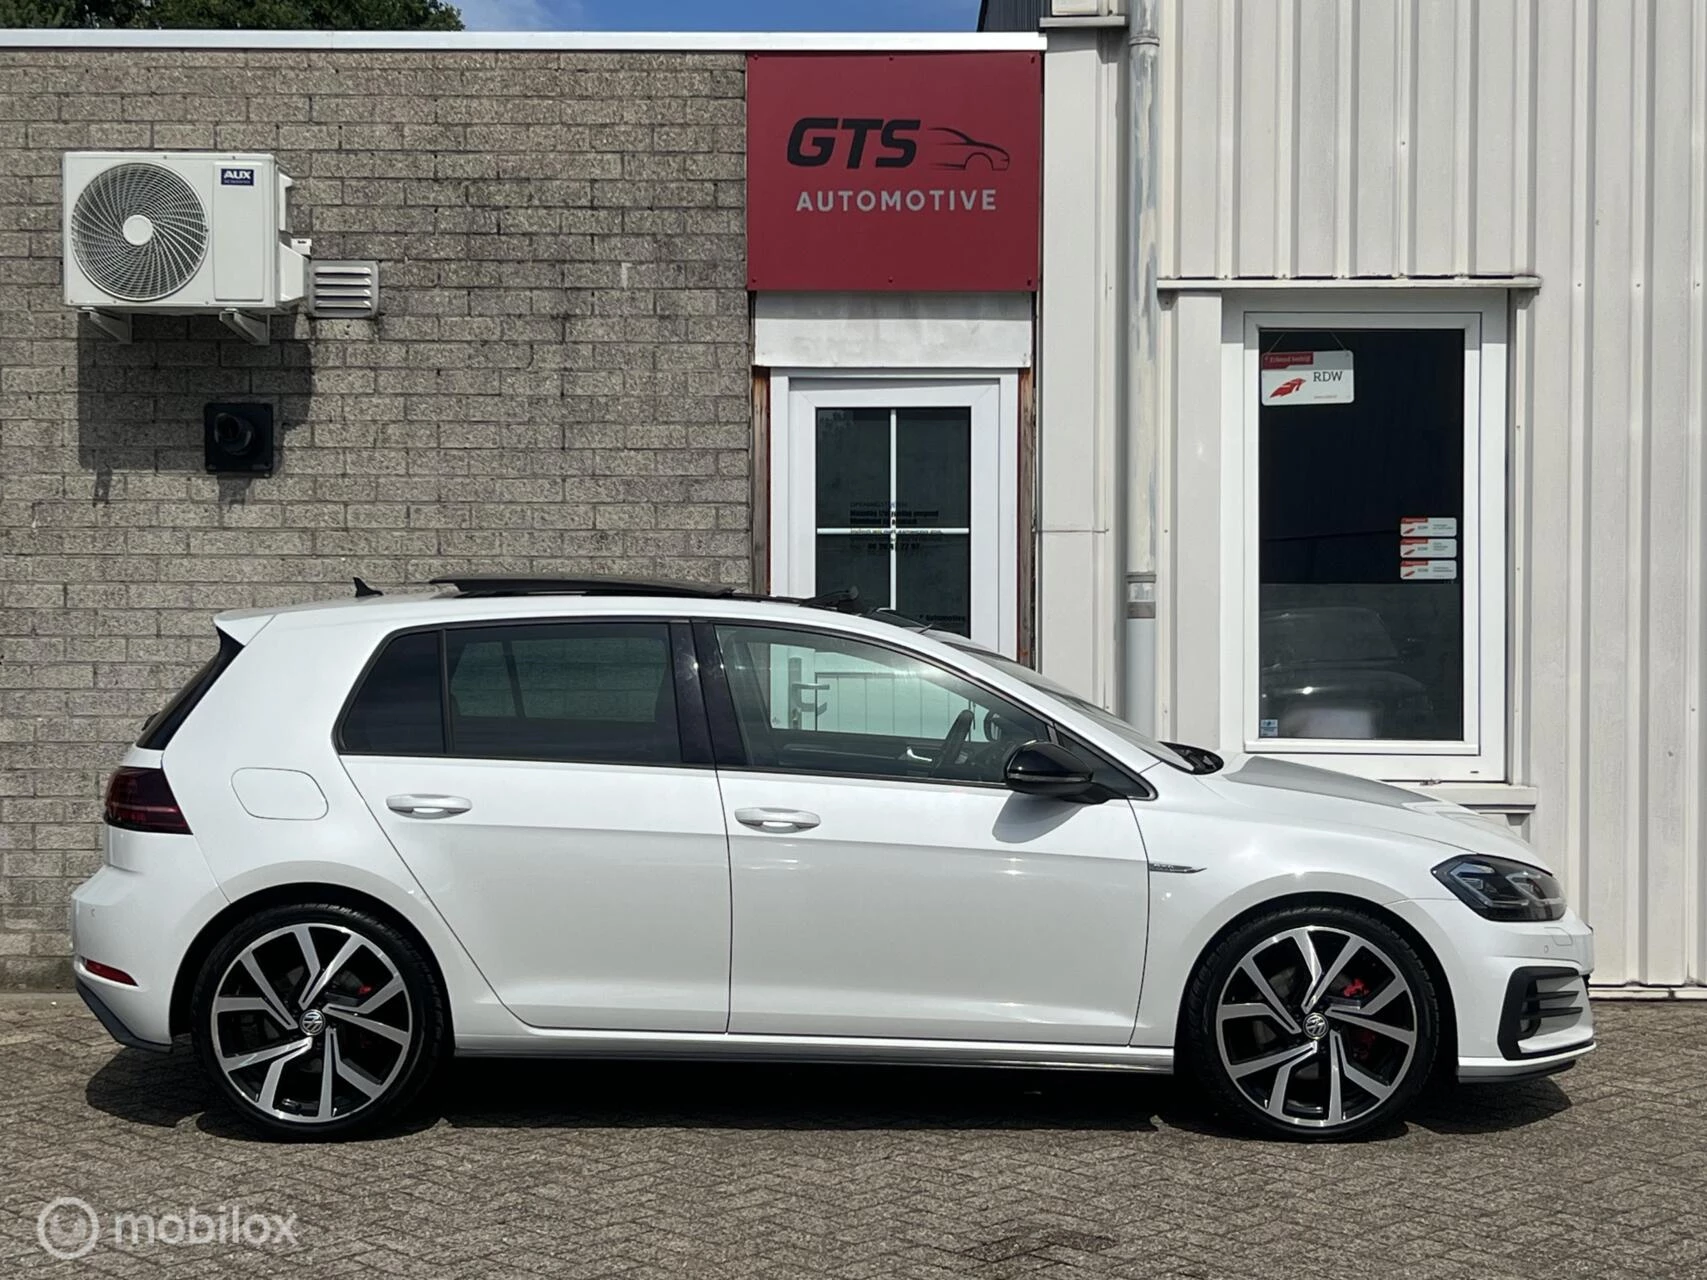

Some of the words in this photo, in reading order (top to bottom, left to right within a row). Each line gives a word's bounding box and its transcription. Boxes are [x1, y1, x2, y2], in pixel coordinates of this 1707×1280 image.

[786, 117, 921, 169] GTS
[224, 170, 251, 179] AUX
[796, 189, 996, 212] AUTOMOTIVE
[1312, 371, 1343, 382] RDW
